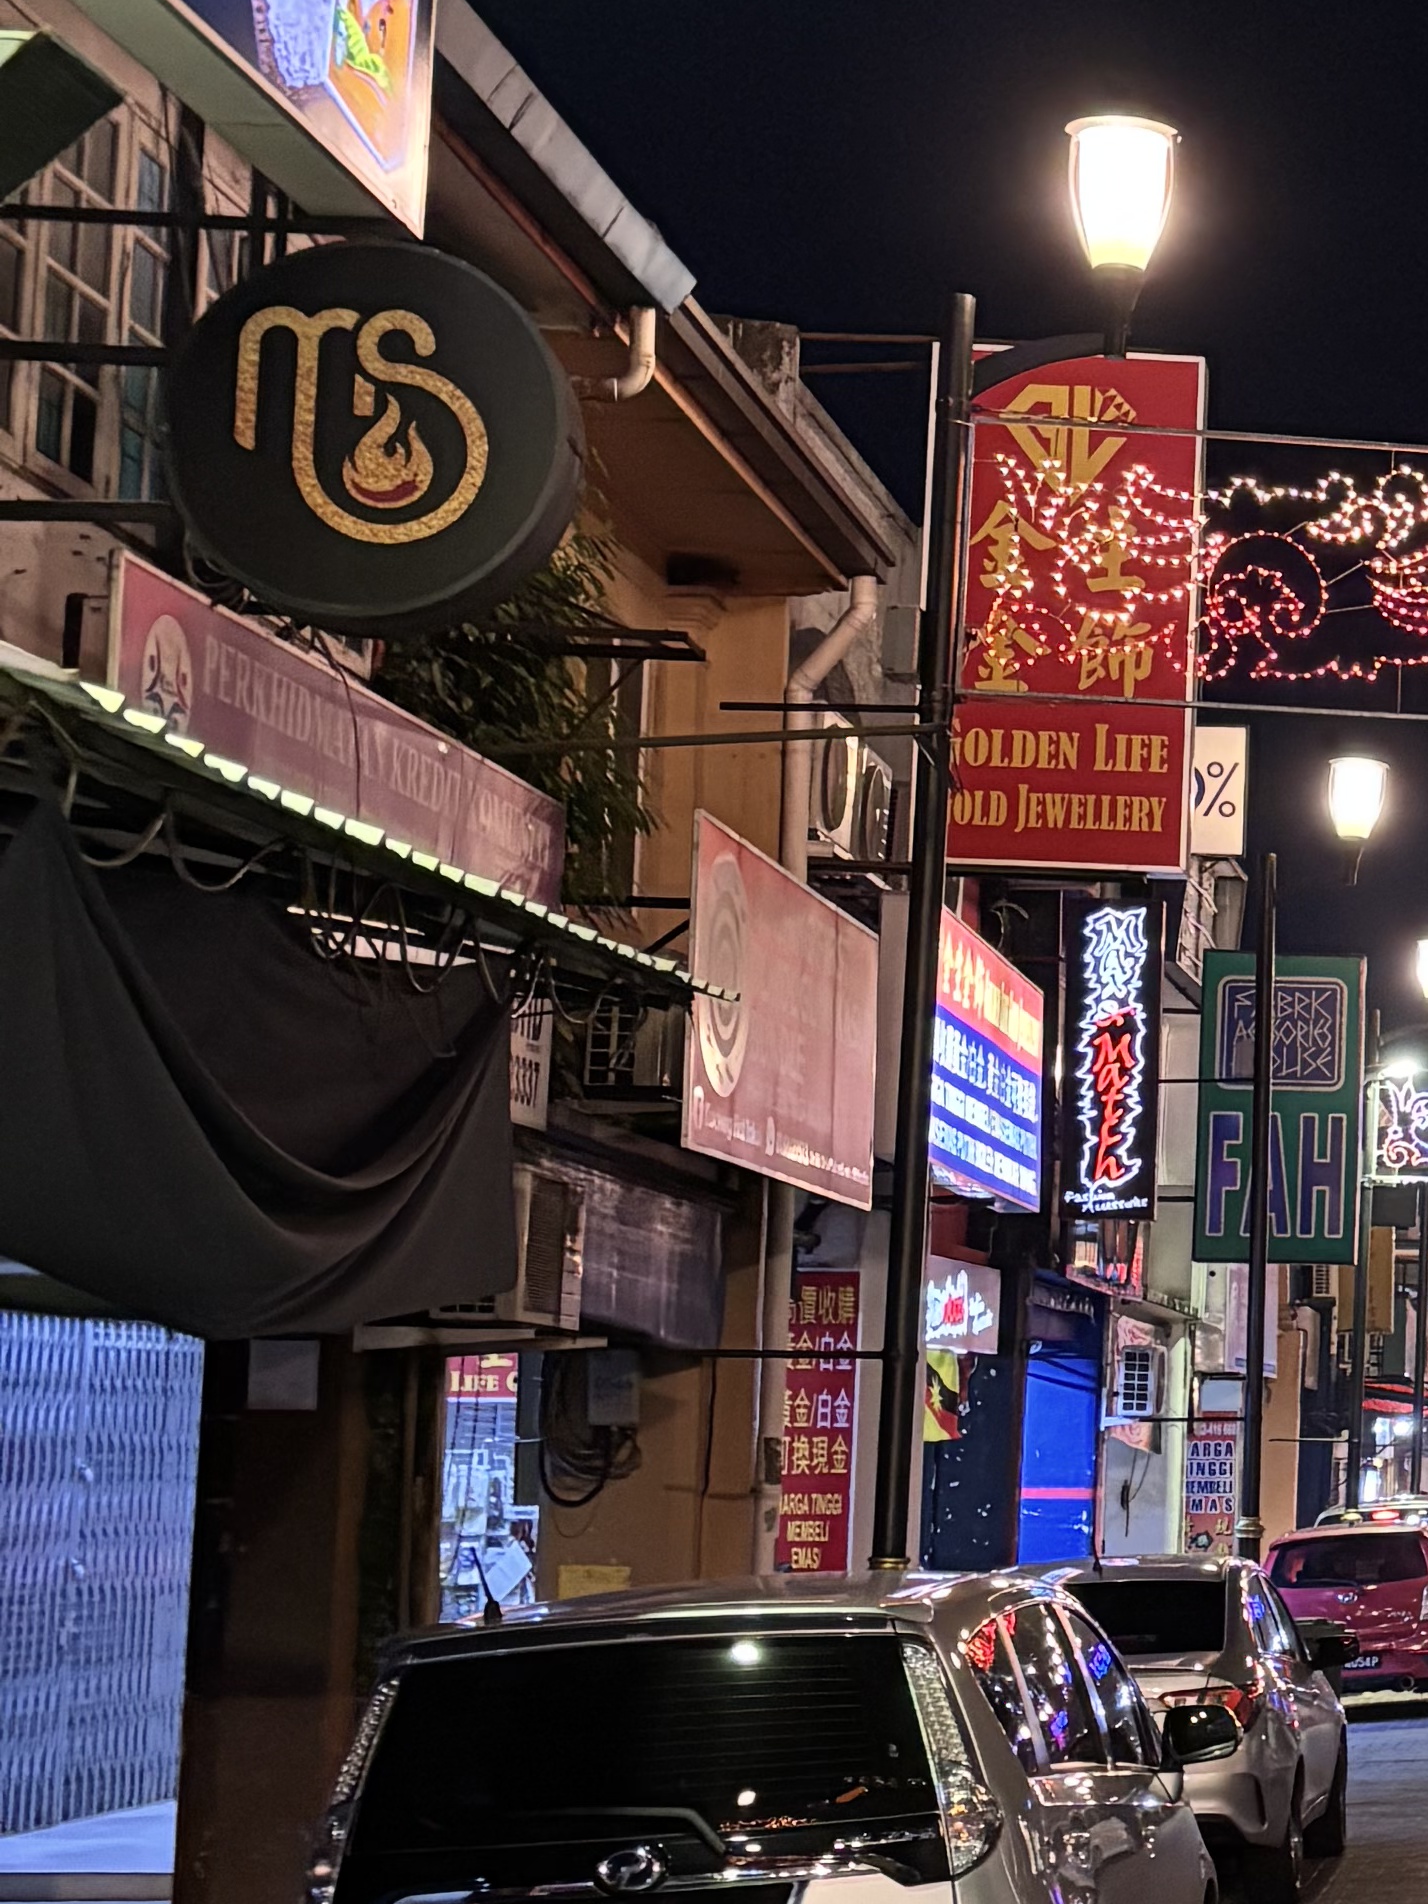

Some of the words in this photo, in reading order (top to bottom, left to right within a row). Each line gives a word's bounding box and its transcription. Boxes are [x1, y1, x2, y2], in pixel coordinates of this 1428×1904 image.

[1093, 723, 1169, 773] LIFE
[950, 788, 1008, 826] OLD
[1014, 783, 1167, 833] JEWELLERY
[1205, 1111, 1347, 1238] FAH
[1190, 1441, 1233, 1457] ARGA
[1187, 1460, 1233, 1476] INGGI
[1190, 1497, 1233, 1512] MAS
